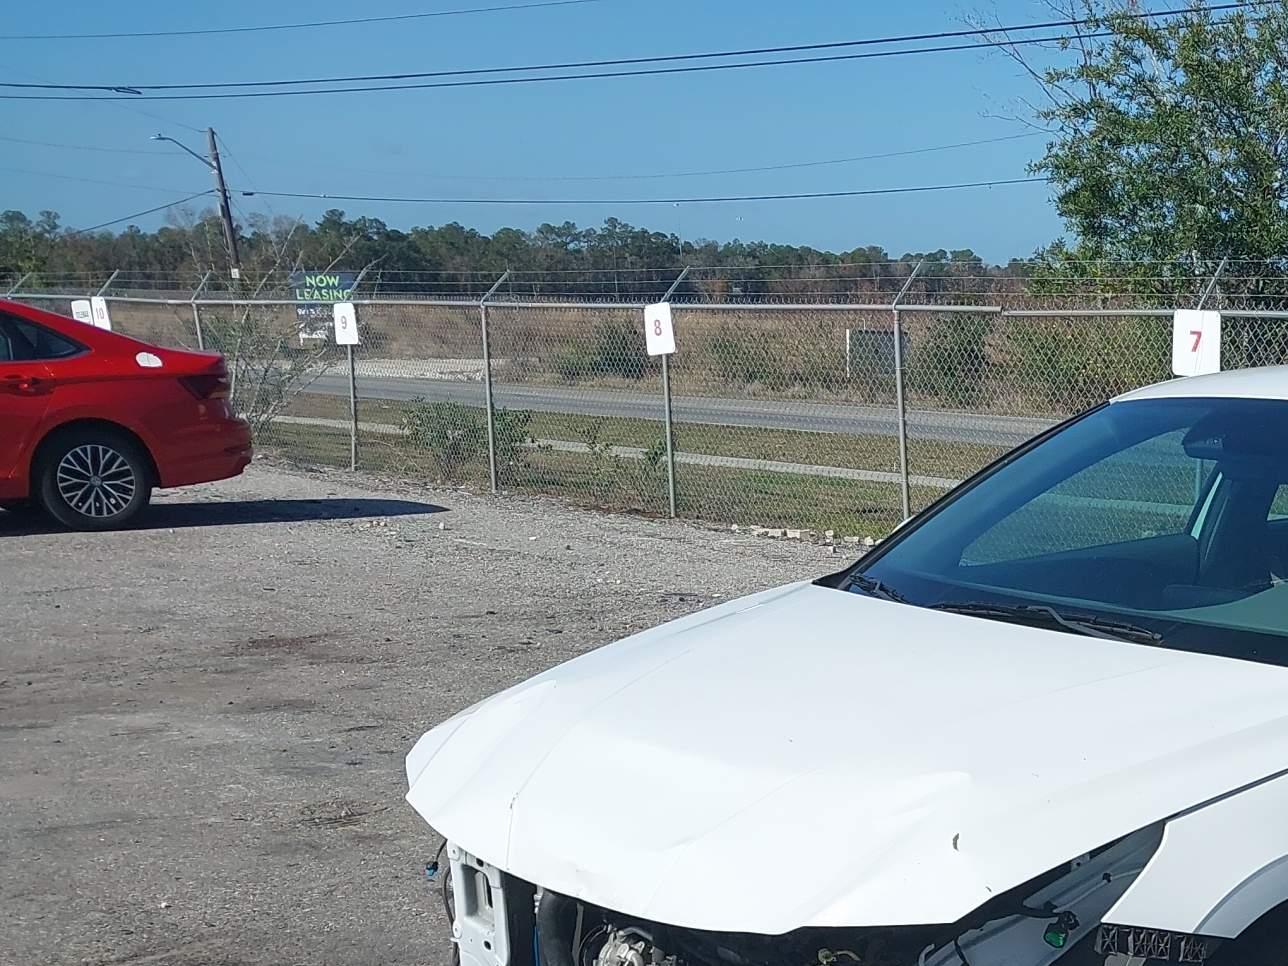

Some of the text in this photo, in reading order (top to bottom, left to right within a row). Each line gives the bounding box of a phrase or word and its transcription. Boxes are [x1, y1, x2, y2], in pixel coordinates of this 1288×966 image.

[305, 275, 340, 287] NOW
[296, 288, 353, 300] LEASING
[95, 307, 105, 320] 10
[340, 315, 348, 330] 9
[654, 319, 662, 336] 8
[1190, 331, 1202, 352] 7
